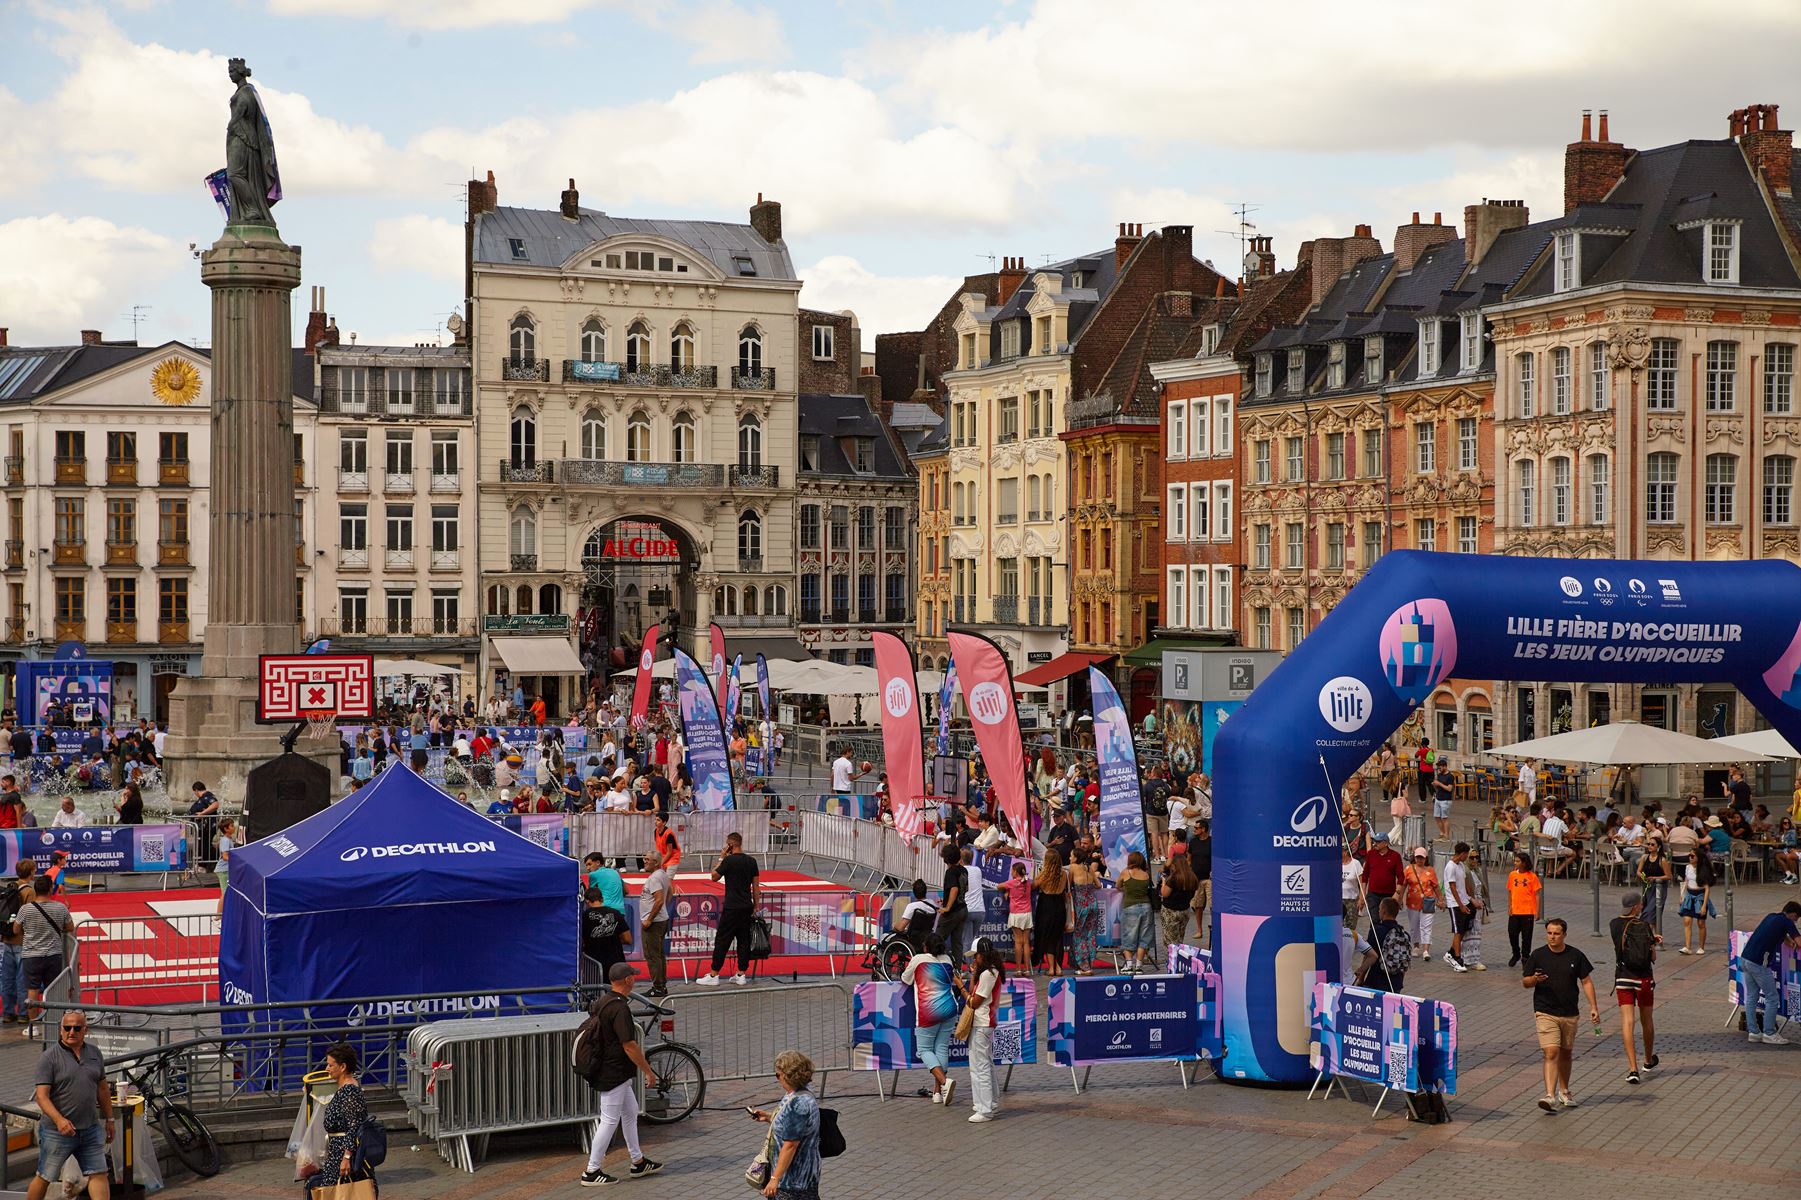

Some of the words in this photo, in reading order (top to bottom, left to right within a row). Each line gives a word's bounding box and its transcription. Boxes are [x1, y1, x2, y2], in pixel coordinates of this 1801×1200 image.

[602, 536, 680, 558] ALCIDE
[1507, 616, 1553, 637] LILLE
[1557, 614, 1608, 639] FIÈRE
[1513, 642, 1549, 659] LES
[1550, 644, 1598, 661] JEUX
[1598, 646, 1725, 663] OLYMPIQUES
[1176, 666, 1183, 682] P
[1233, 667, 1245, 683] P
[1316, 739, 1357, 747] COLLECTIVITÉ
[1273, 835, 1338, 848] DECATHLON
[371, 841, 496, 858] DECATHLON
[71, 860, 120, 868] OLYMPIQUES
[665, 930, 687, 939] LILLE
[688, 928, 712, 939] FIÈRE
[979, 922, 1001, 932] FIÈRE
[670, 942, 685, 950] LES
[688, 941, 708, 950] JEUX
[233, 987, 253, 1005] DECAT
[377, 996, 499, 1019] DECATHLON
[1085, 1014, 1111, 1022] MERCI
[1118, 1012, 1136, 1021] NOS
[1136, 1011, 1187, 1020] PARTENAIRES
[1348, 1024, 1361, 1036] LILLE
[1362, 1025, 1377, 1038] FIÈRE
[1343, 1036, 1381, 1051] D'ACCUEILLIR
[1350, 1048, 1360, 1057] LES
[1360, 1049, 1373, 1060] JEUX
[1343, 1058, 1380, 1074] OLYMPIQUES
